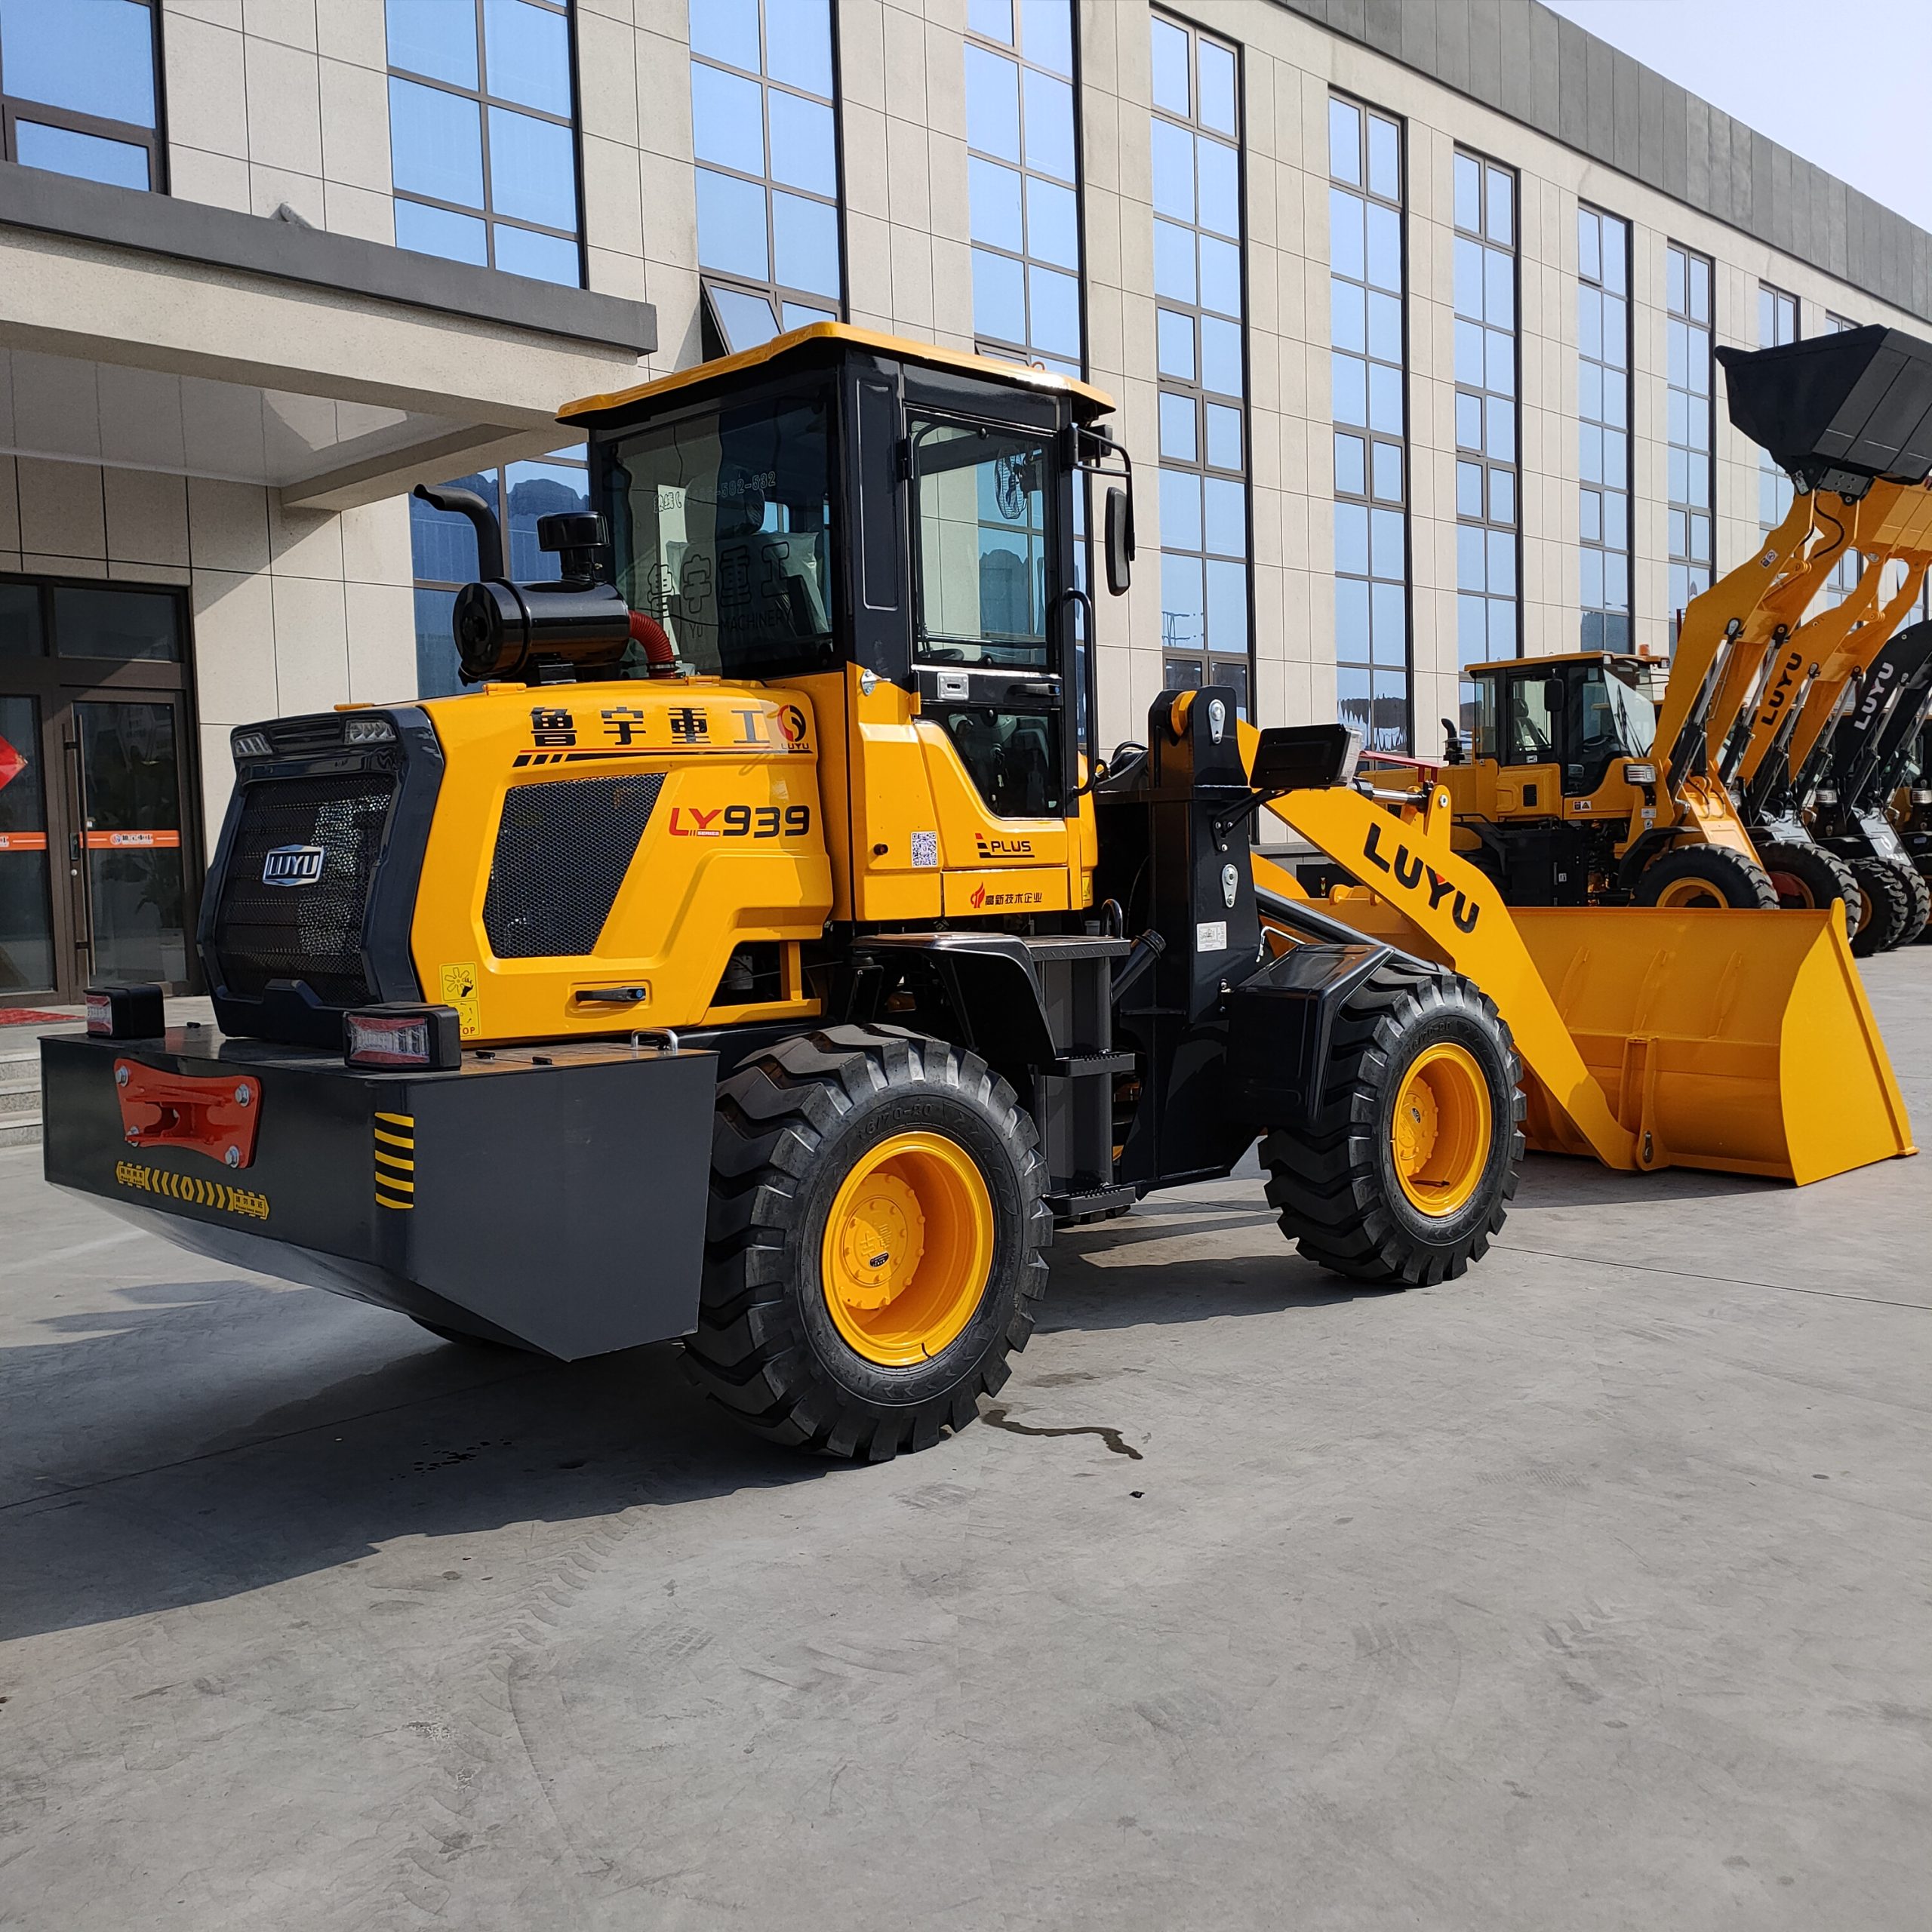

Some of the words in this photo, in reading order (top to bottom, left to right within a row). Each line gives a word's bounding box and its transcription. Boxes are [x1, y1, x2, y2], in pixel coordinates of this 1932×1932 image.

[1761, 652, 1802, 726] LUYU
[1854, 662, 1894, 731] LUYU
[530, 706, 771, 747] 鲁宇重工
[267, 855, 319, 875] LUYU
[991, 840, 1032, 853] PLUS
[1363, 822, 1480, 934] LUYU
[985, 892, 1042, 906] 高新技术企业
